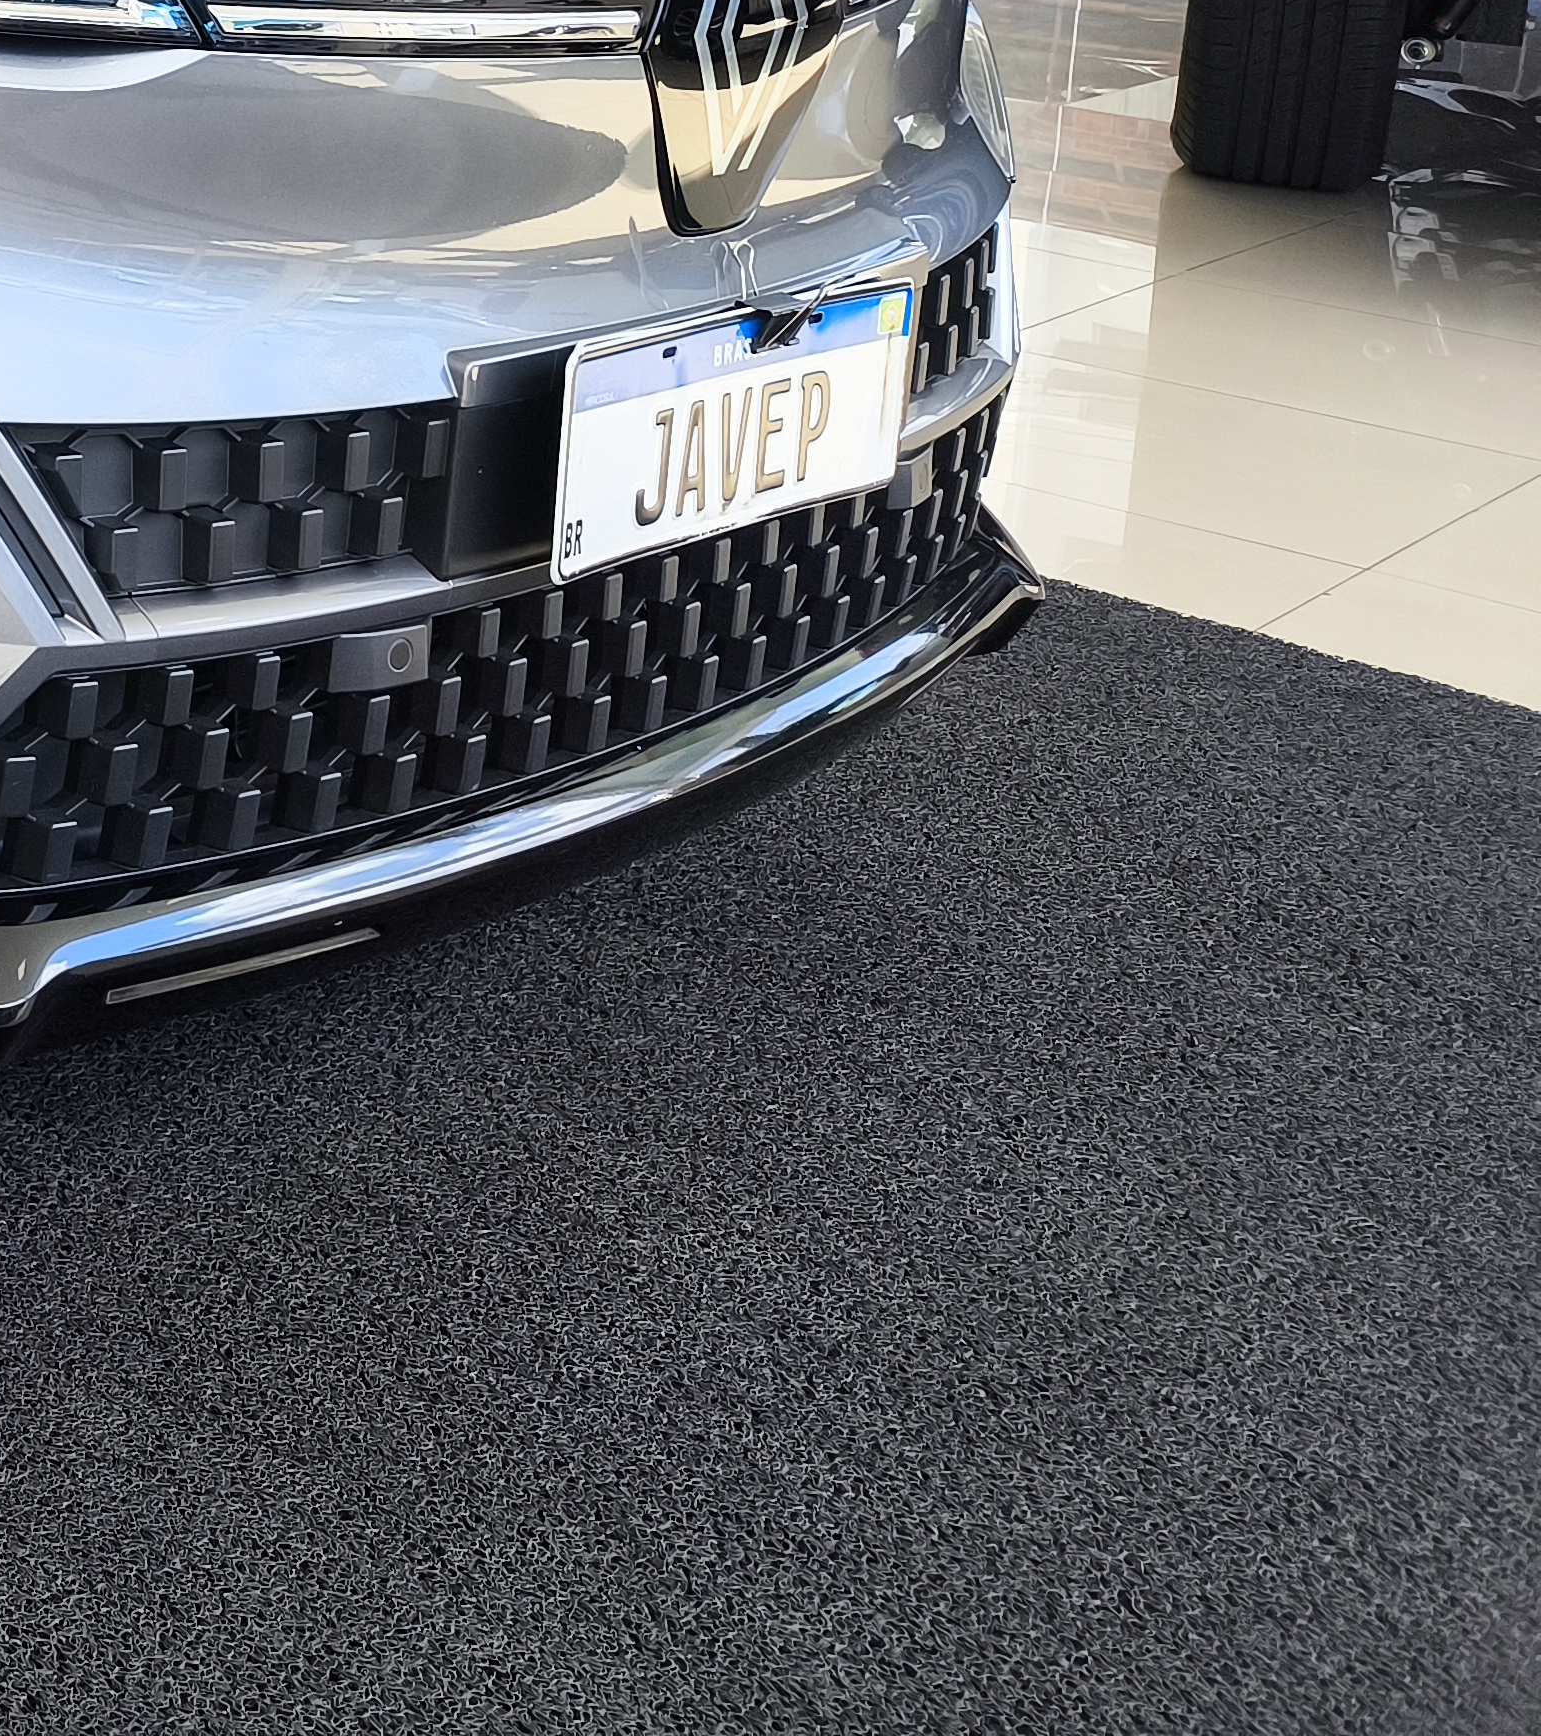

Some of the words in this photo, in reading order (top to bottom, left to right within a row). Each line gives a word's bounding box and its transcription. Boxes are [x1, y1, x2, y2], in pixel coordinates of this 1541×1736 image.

[713, 337, 768, 368] BRAS
[634, 370, 831, 527] JAVEP
[563, 519, 584, 560] BR
